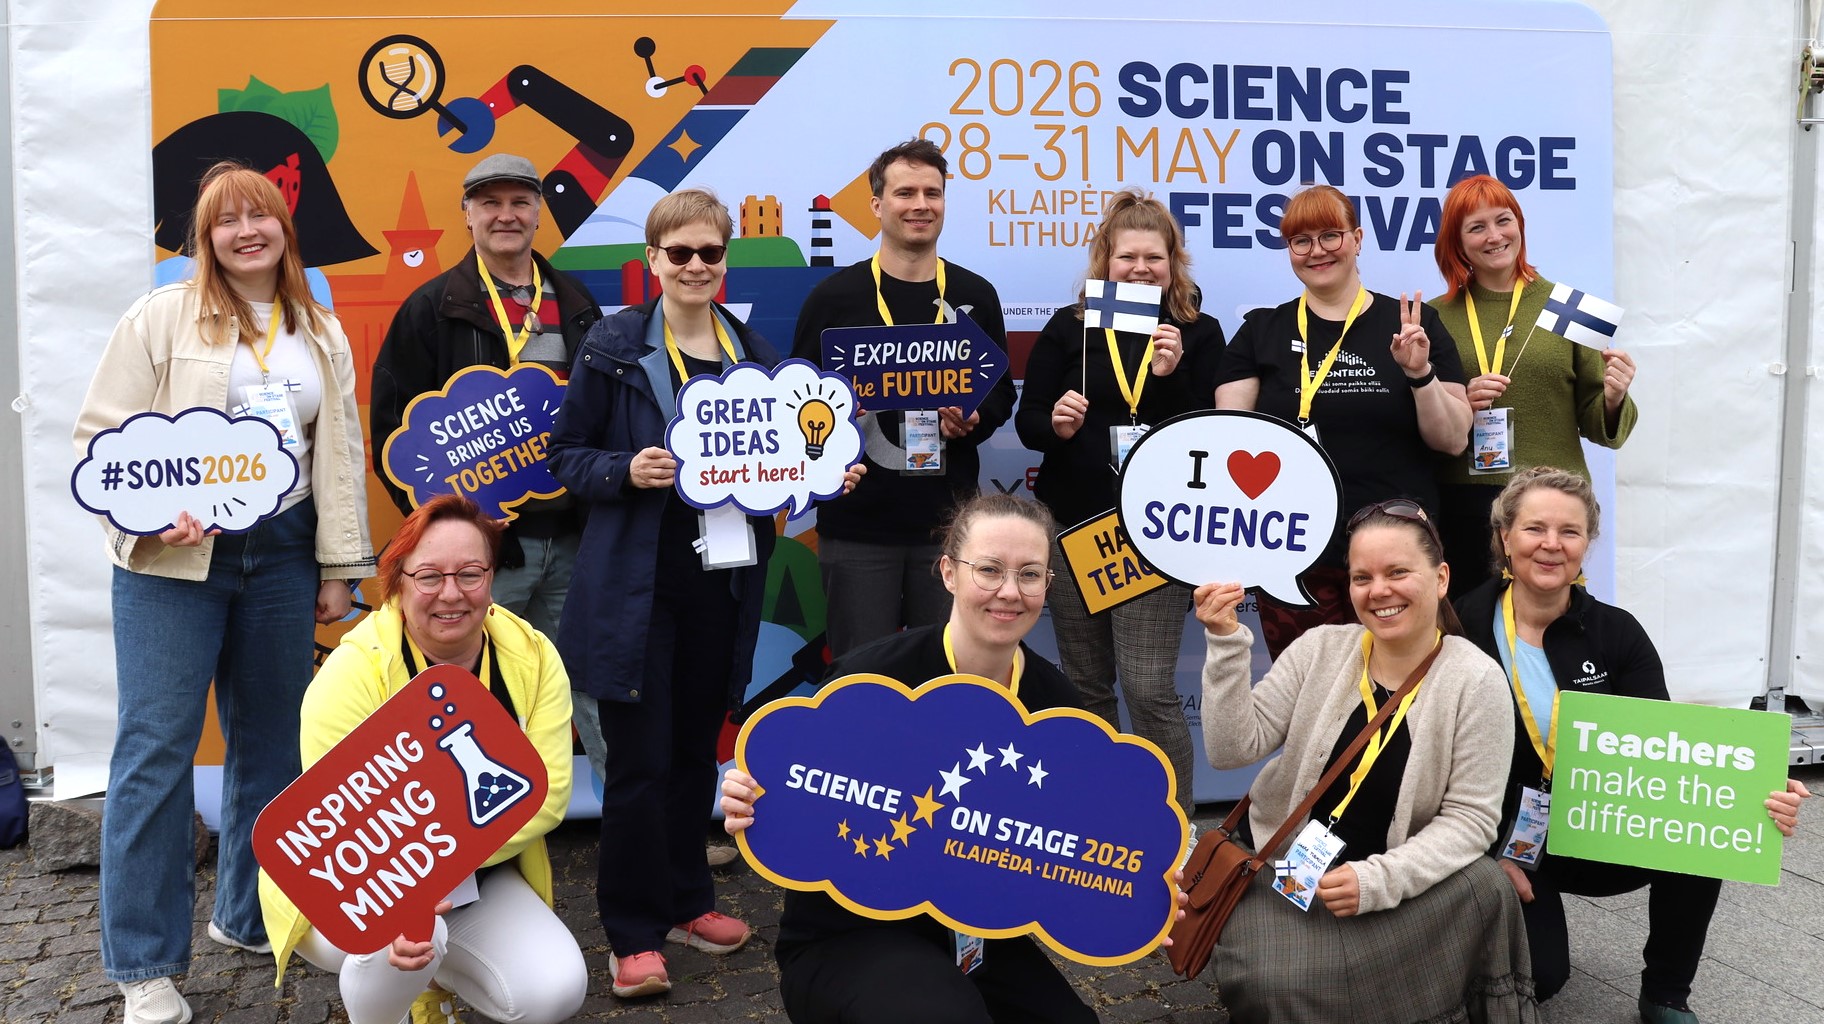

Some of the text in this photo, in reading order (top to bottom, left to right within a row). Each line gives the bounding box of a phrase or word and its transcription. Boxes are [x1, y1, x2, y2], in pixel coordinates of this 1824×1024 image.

[948, 57, 1411, 125] 2026 SCIENCE
[1115, 125, 1241, 184] MAY
[1250, 129, 1345, 187] ON
[1362, 131, 1577, 191] STAGE
[988, 183, 1118, 216] KLAIPĖ
[1167, 191, 1444, 252] FESVA
[988, 220, 1097, 248] LITHUA
[1003, 307, 1033, 316] UNDER
[1035, 307, 1052, 316] THE
[852, 338, 972, 367] EXPLORING
[1309, 366, 1376, 378] EONTEKIÖ
[852, 367, 973, 398] he FUTURE
[429, 387, 526, 445] SCIENCE
[696, 396, 777, 426] GREAT
[446, 416, 533, 467] BRINGS US
[698, 428, 780, 458] IDEAS
[101, 452, 267, 491] #SONS2026
[699, 460, 805, 486] start here!
[1187, 450, 1209, 489] I
[1142, 500, 1310, 552] SCIENCE
[1572, 720, 1756, 771] Teachers
[275, 731, 424, 866] INSPIRING
[785, 764, 902, 814] SCIENCE
[1570, 766, 1736, 810] make the
[309, 780, 436, 891] YOUNG
[950, 806, 1145, 874] ON STAGE 2026
[1567, 800, 1763, 854] difference!
[339, 822, 457, 932] MINDS
[943, 838, 1134, 898] KLAIPĖDA LITHUANIA
